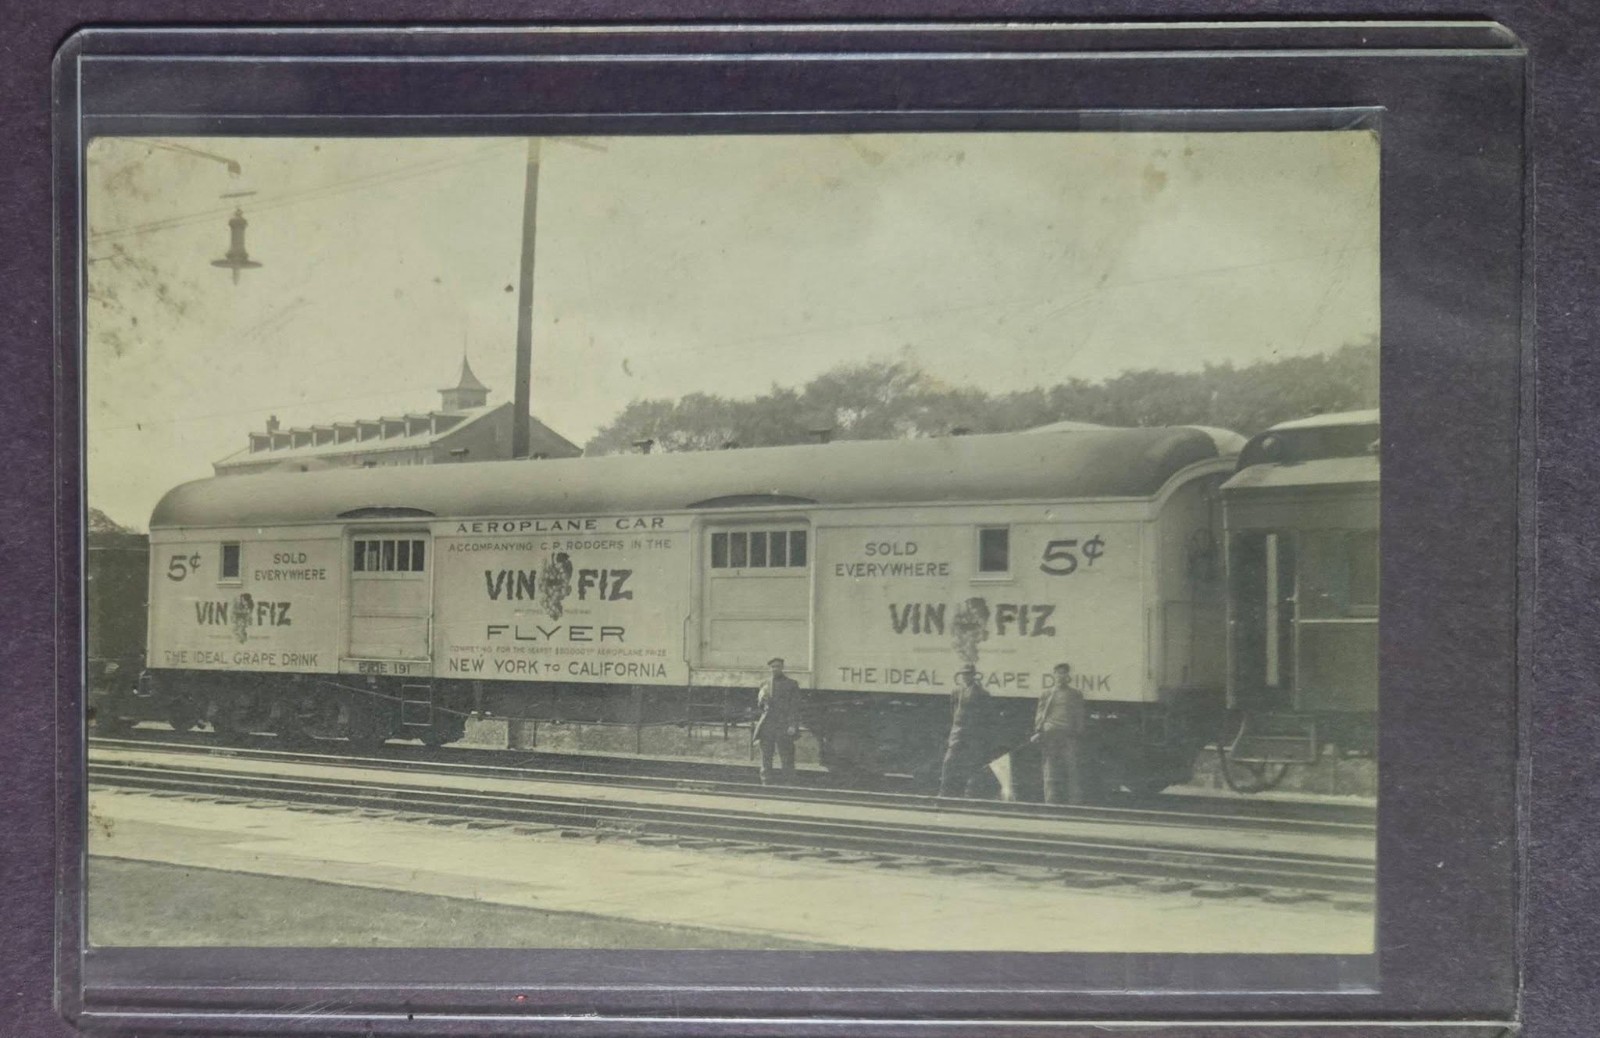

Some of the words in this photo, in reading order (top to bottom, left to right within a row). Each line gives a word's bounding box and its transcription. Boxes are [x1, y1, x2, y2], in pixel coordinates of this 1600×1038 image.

[456, 518, 598, 534] AEROPLANE
[615, 517, 665, 530] CAR
[449, 543, 533, 552] ACCOMPANYING
[566, 540, 624, 550] RODGERS
[631, 540, 641, 549] IN
[646, 539, 672, 549] THE
[865, 542, 918, 556] SOLD
[273, 553, 307, 564] SOLD
[1039, 534, 1105, 576] 5¢
[167, 551, 202, 582] 5¢
[254, 569, 326, 581] EVERYWHERE
[835, 563, 949, 577] EVERYWHERE
[484, 569, 537, 601] VIN
[578, 569, 633, 601] FIZ
[195, 601, 228, 626] VIN
[257, 601, 292, 627] FIZ
[889, 603, 946, 635] VIN
[995, 603, 1056, 637] FIZ
[487, 625, 625, 642] FLYER
[164, 650, 188, 663] THE
[193, 650, 228, 664] IDEAL
[233, 652, 276, 666] GRAPE
[282, 653, 318, 667] DRINK
[449, 658, 485, 672] NEW
[494, 659, 538, 674] YORK
[568, 661, 667, 678] CALIFORNIA
[838, 667, 877, 683] THE
[885, 669, 944, 685] IDEAL
